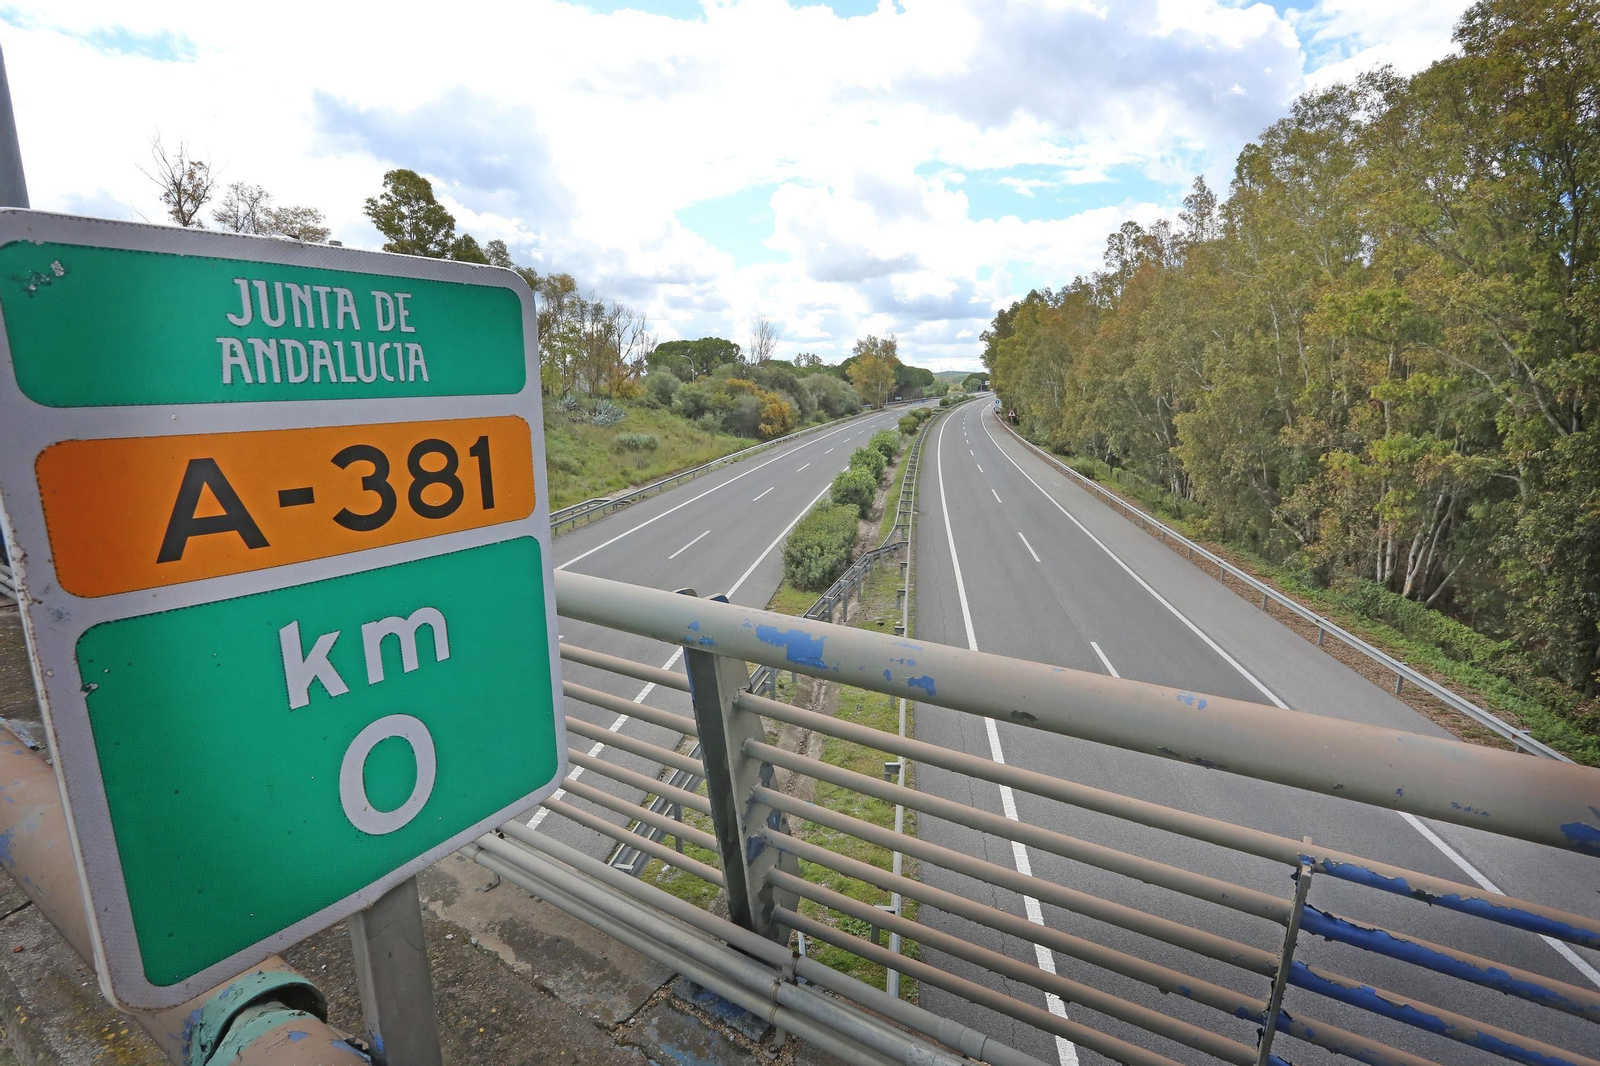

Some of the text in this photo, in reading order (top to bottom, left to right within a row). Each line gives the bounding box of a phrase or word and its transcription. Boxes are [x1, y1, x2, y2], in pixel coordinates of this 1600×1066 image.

[226, 277, 416, 333] JUNTA DE
[216, 337, 429, 384] ANDALUCIA
[156, 434, 497, 564] A-381
[279, 606, 451, 710] km
[339, 714, 437, 835] 0
